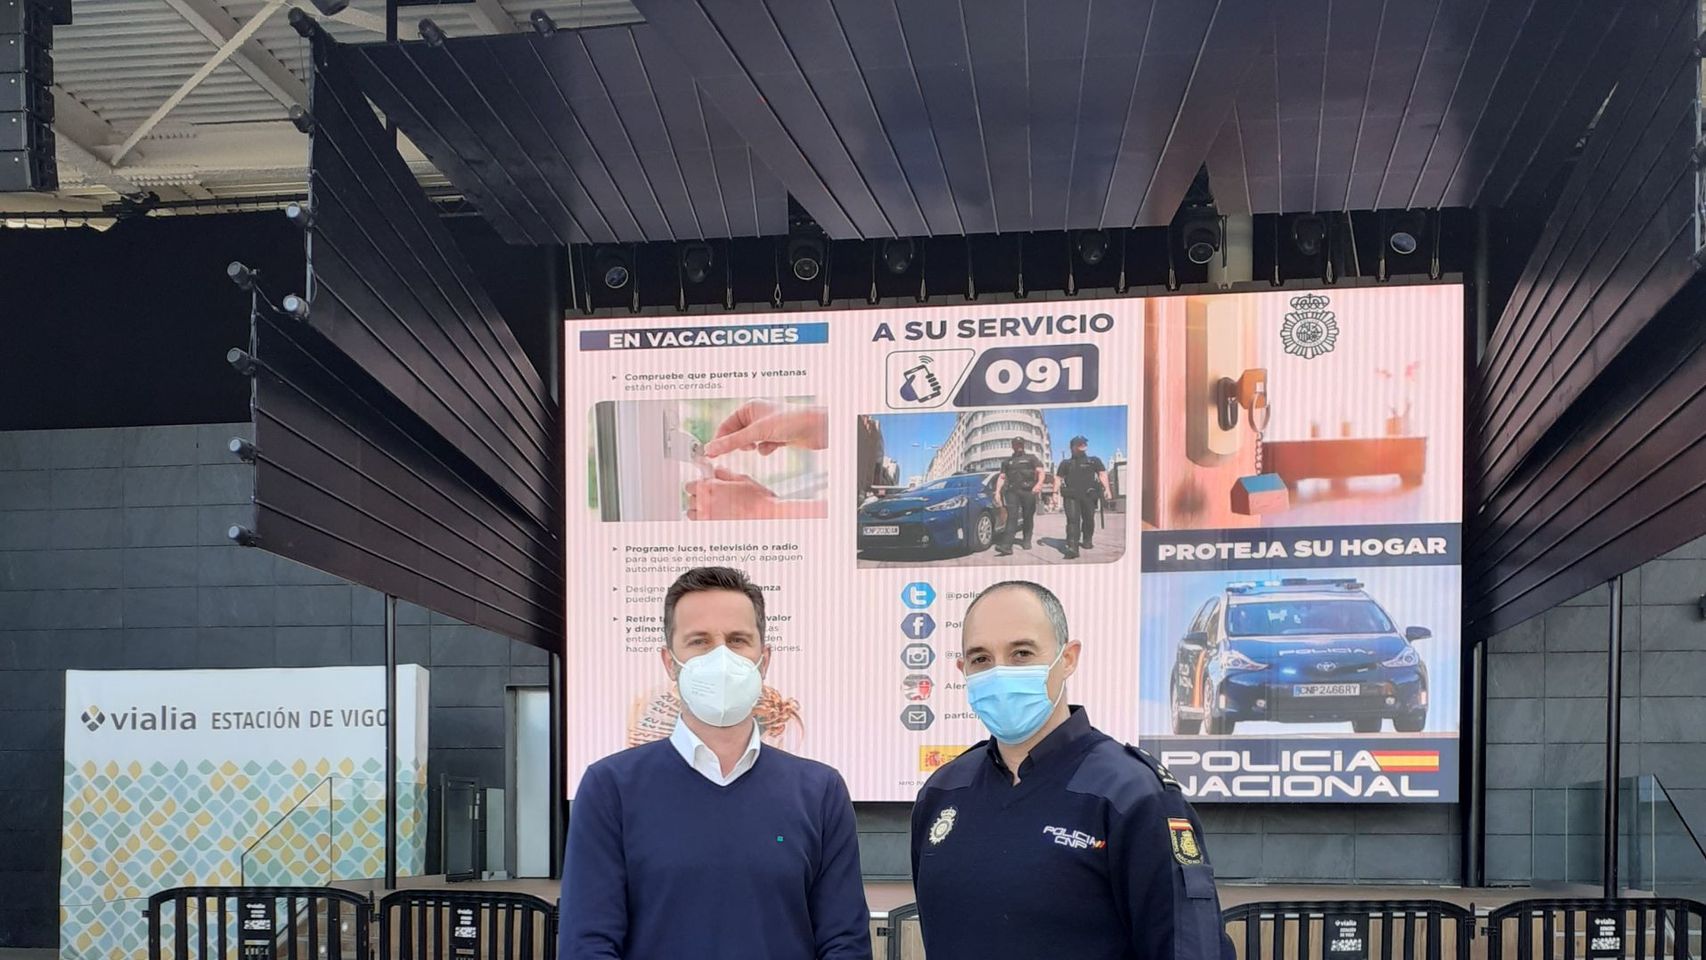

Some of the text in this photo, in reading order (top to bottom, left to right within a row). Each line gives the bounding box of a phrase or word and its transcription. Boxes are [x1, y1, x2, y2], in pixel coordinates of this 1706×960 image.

[872, 313, 1114, 341] A SU SERVICIO
[609, 328, 799, 348] EN VACACIONES
[624, 372, 684, 381] Compruebe
[709, 371, 749, 379] puertas
[751, 371, 758, 379] y
[760, 369, 807, 377] ventanas
[985, 356, 1084, 394] 091
[624, 383, 652, 391] están
[654, 382, 677, 391] bien
[625, 545, 675, 553] Programe
[677, 544, 707, 552] luces,
[709, 543, 759, 551] televisión
[771, 542, 799, 551] radio
[1158, 537, 1447, 560] PROTEJA SU HOGAR
[685, 553, 738, 562] enciendan
[740, 553, 756, 562] y/o
[759, 553, 803, 562] apaguen
[625, 585, 666, 593] Designe
[625, 596, 663, 604] pueden
[766, 614, 792, 622] valor
[625, 645, 654, 653] hacer
[111, 705, 387, 730] vialia ESTACIÓN DE VIGO
[1043, 825, 1096, 846] POLICIA
